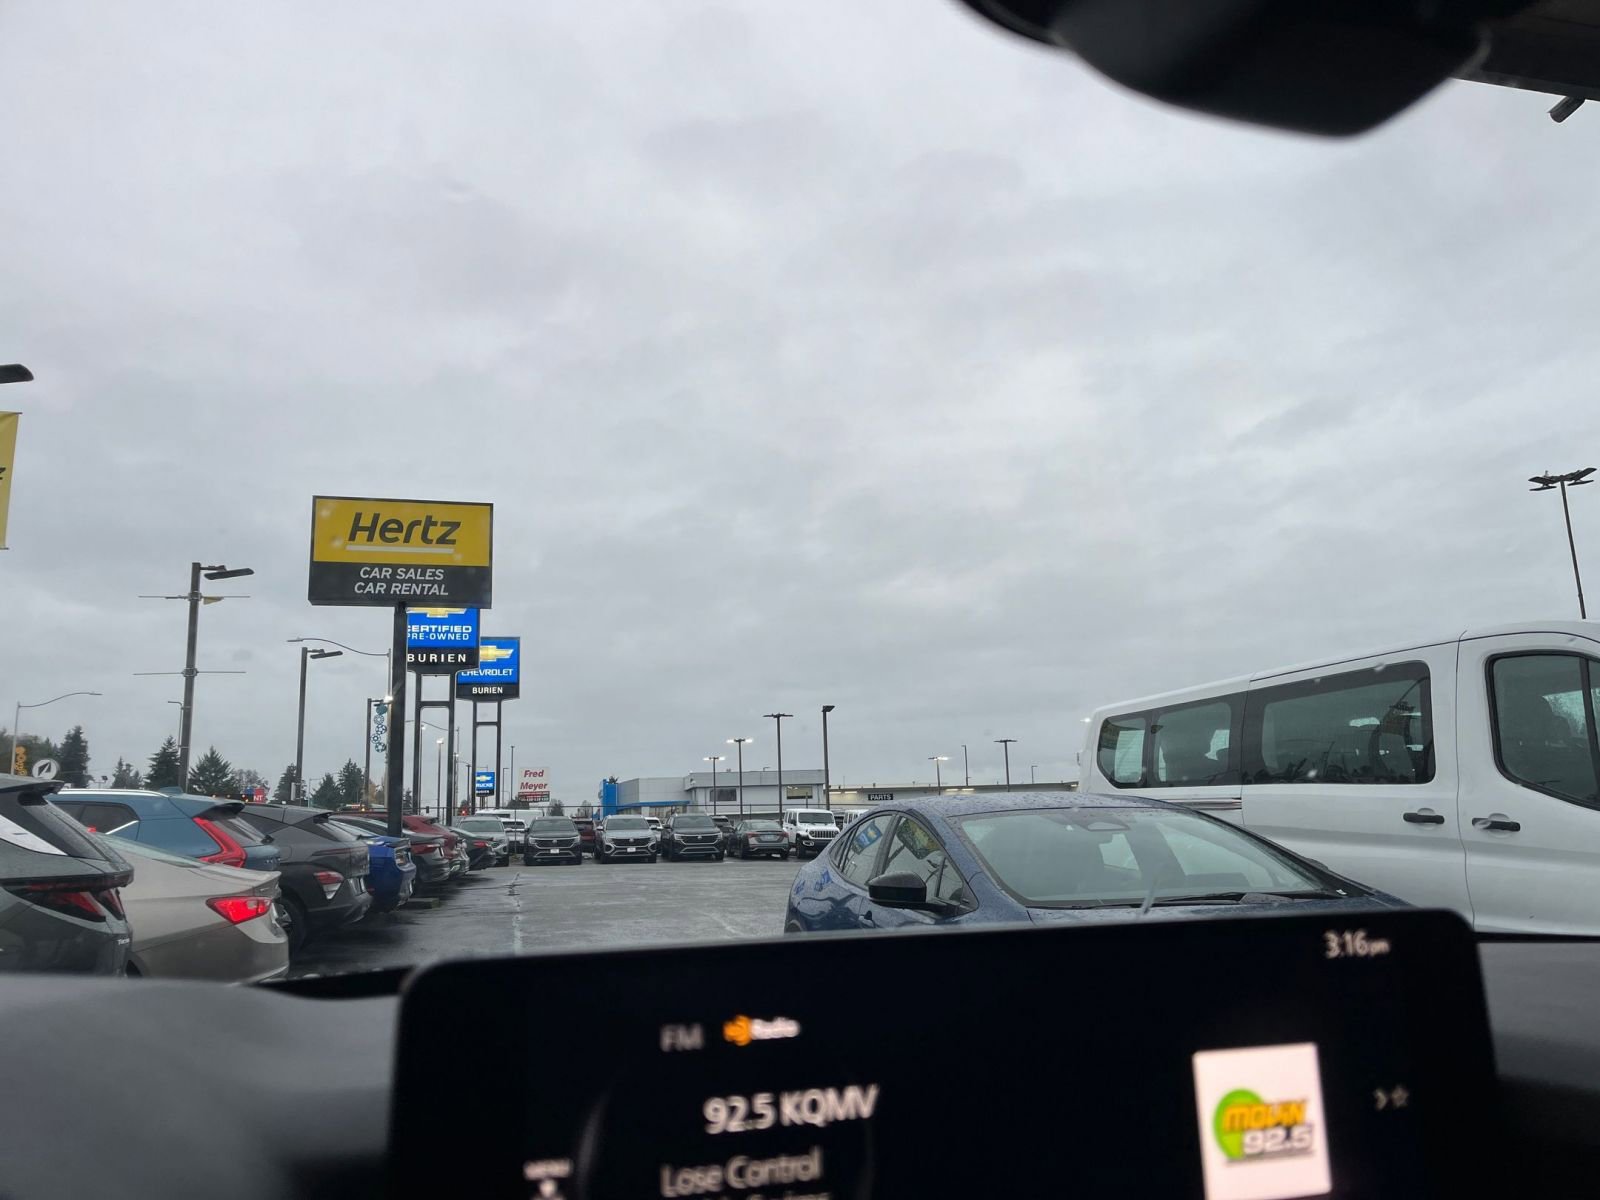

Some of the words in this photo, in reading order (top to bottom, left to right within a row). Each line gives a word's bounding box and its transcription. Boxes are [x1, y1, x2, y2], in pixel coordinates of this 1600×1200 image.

[349, 512, 462, 545] Hertz
[359, 566, 393, 580] CAR
[396, 567, 445, 581] SALES
[354, 582, 387, 595] CAR
[390, 583, 449, 596] RENTAL
[407, 653, 467, 663] BURIEN
[472, 686, 503, 694] BURIEN
[524, 769, 544, 778] Fred
[520, 782, 548, 791] Meyer
[660, 1024, 705, 1052] FM
[703, 1092, 777, 1135] 92.5
[780, 1084, 879, 1127] KQMV
[1243, 1123, 1313, 1154] 92.5
[660, 1164, 723, 1198] Lose
[725, 1145, 824, 1189] Control
